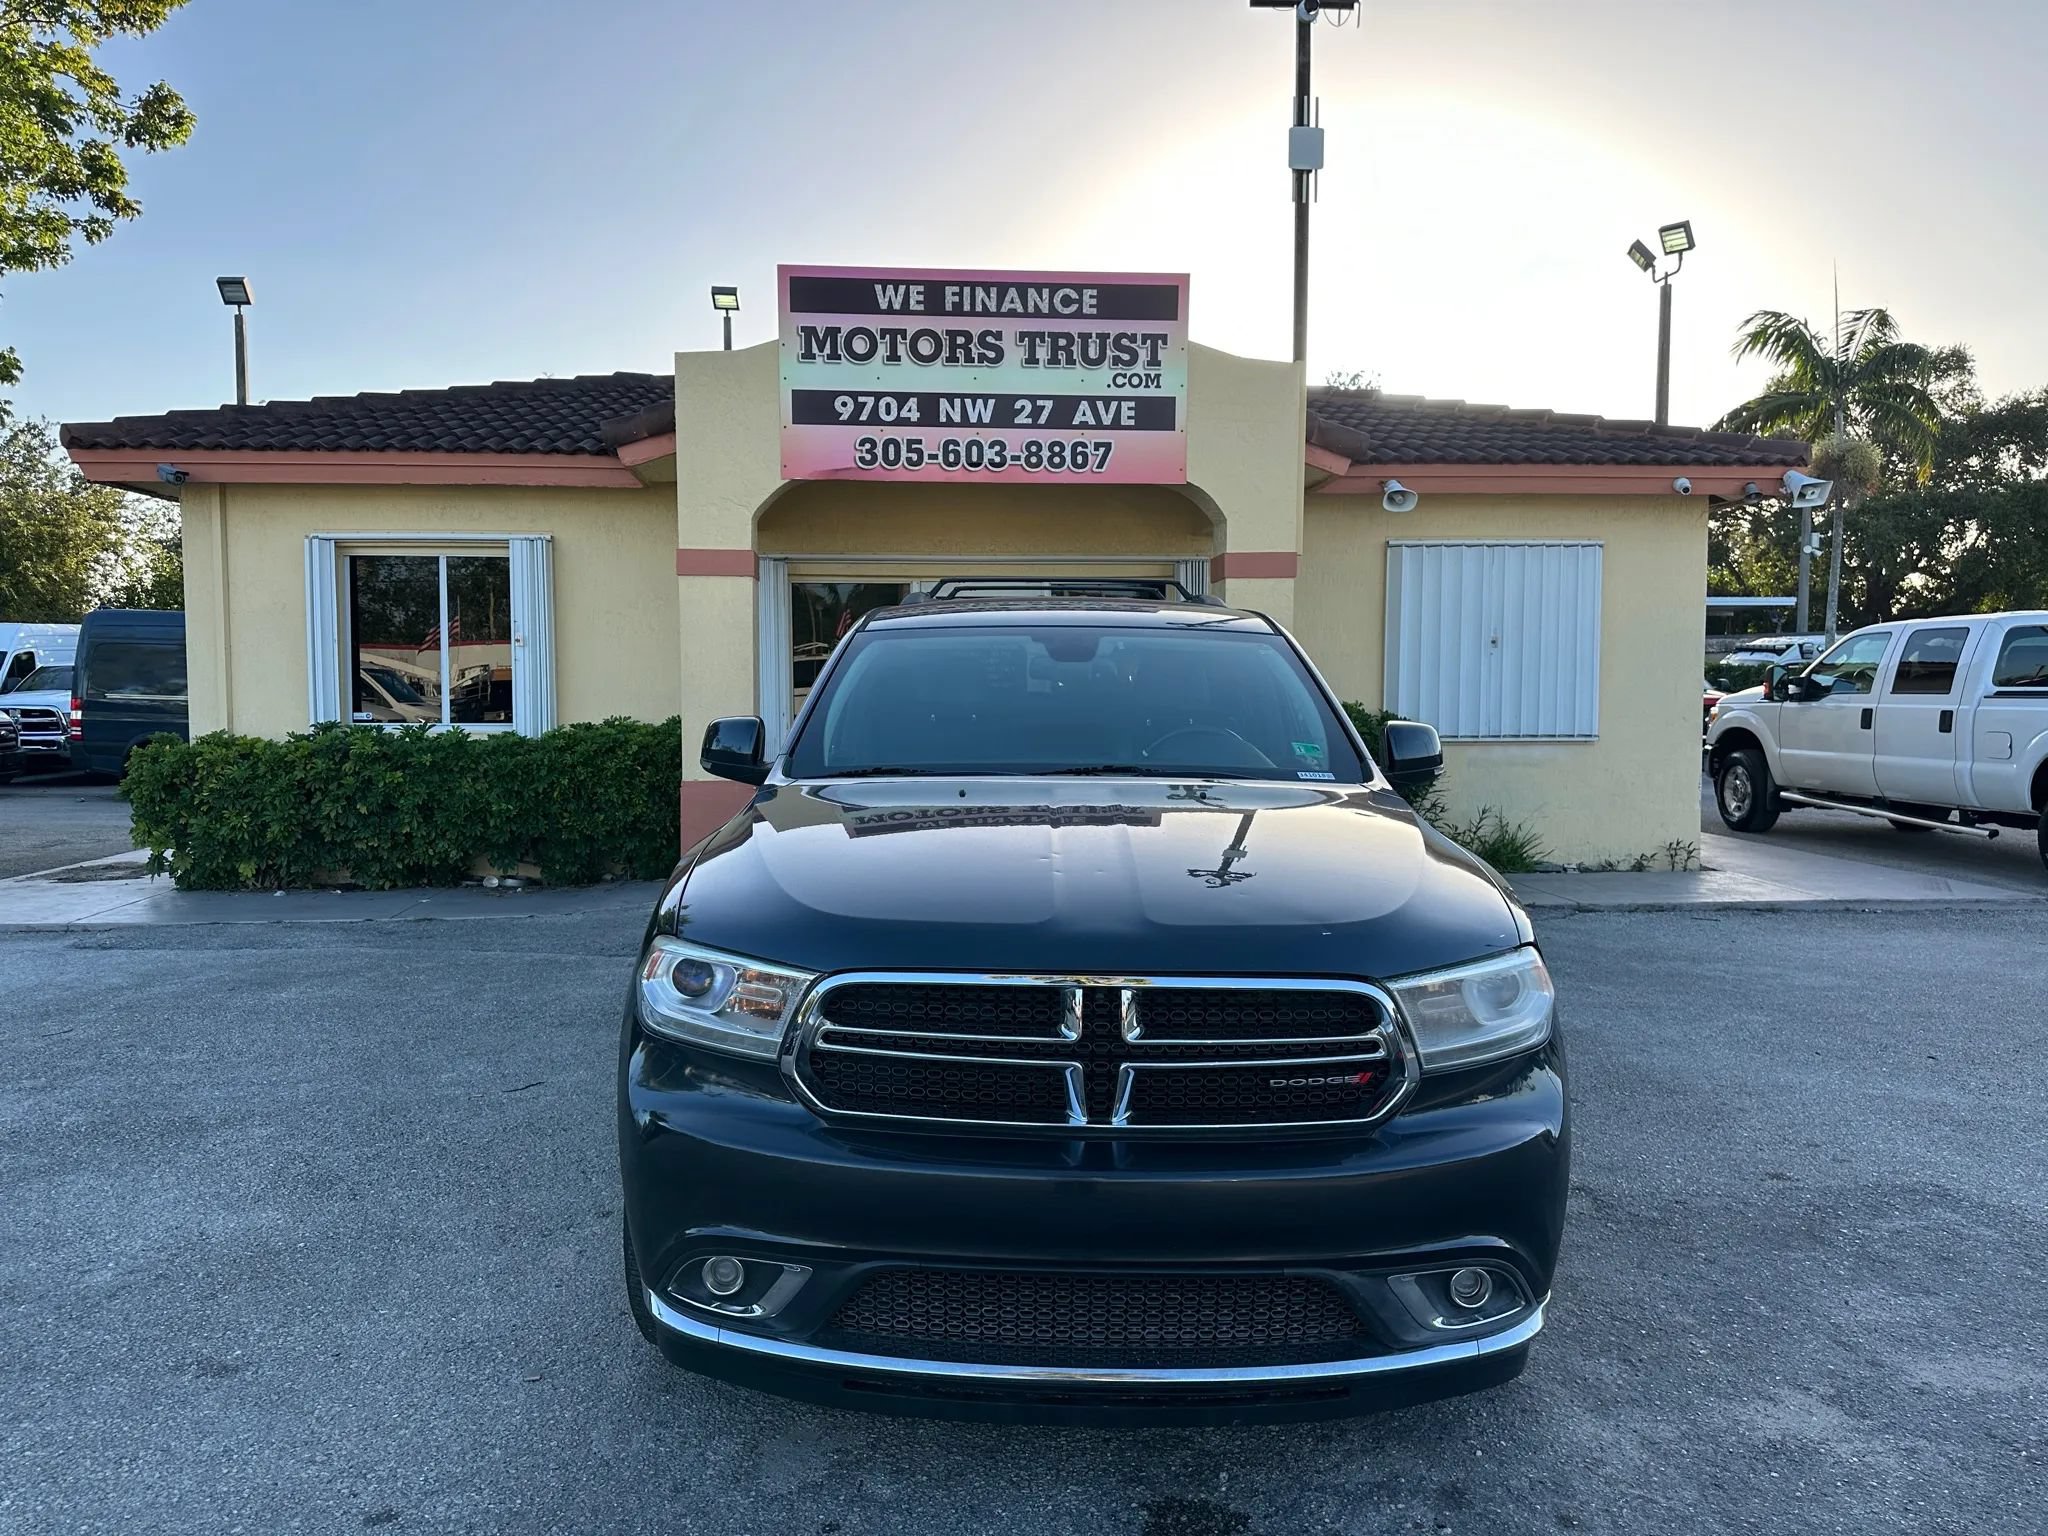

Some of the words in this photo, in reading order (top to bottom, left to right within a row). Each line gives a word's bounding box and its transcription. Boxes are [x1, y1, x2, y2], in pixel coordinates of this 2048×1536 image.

[874, 283, 925, 311] WE
[944, 285, 1098, 315] FINANCE
[798, 324, 1006, 367] MOTORS
[1016, 329, 1169, 370] TRUST
[1106, 372, 1163, 389] .COM
[833, 395, 921, 422] 9704
[939, 397, 996, 424] NW
[1013, 398, 1054, 425] 27
[1071, 400, 1136, 426] AVE
[855, 435, 1115, 473] 305-603-8867
[1269, 1075, 1361, 1087] DODGE
